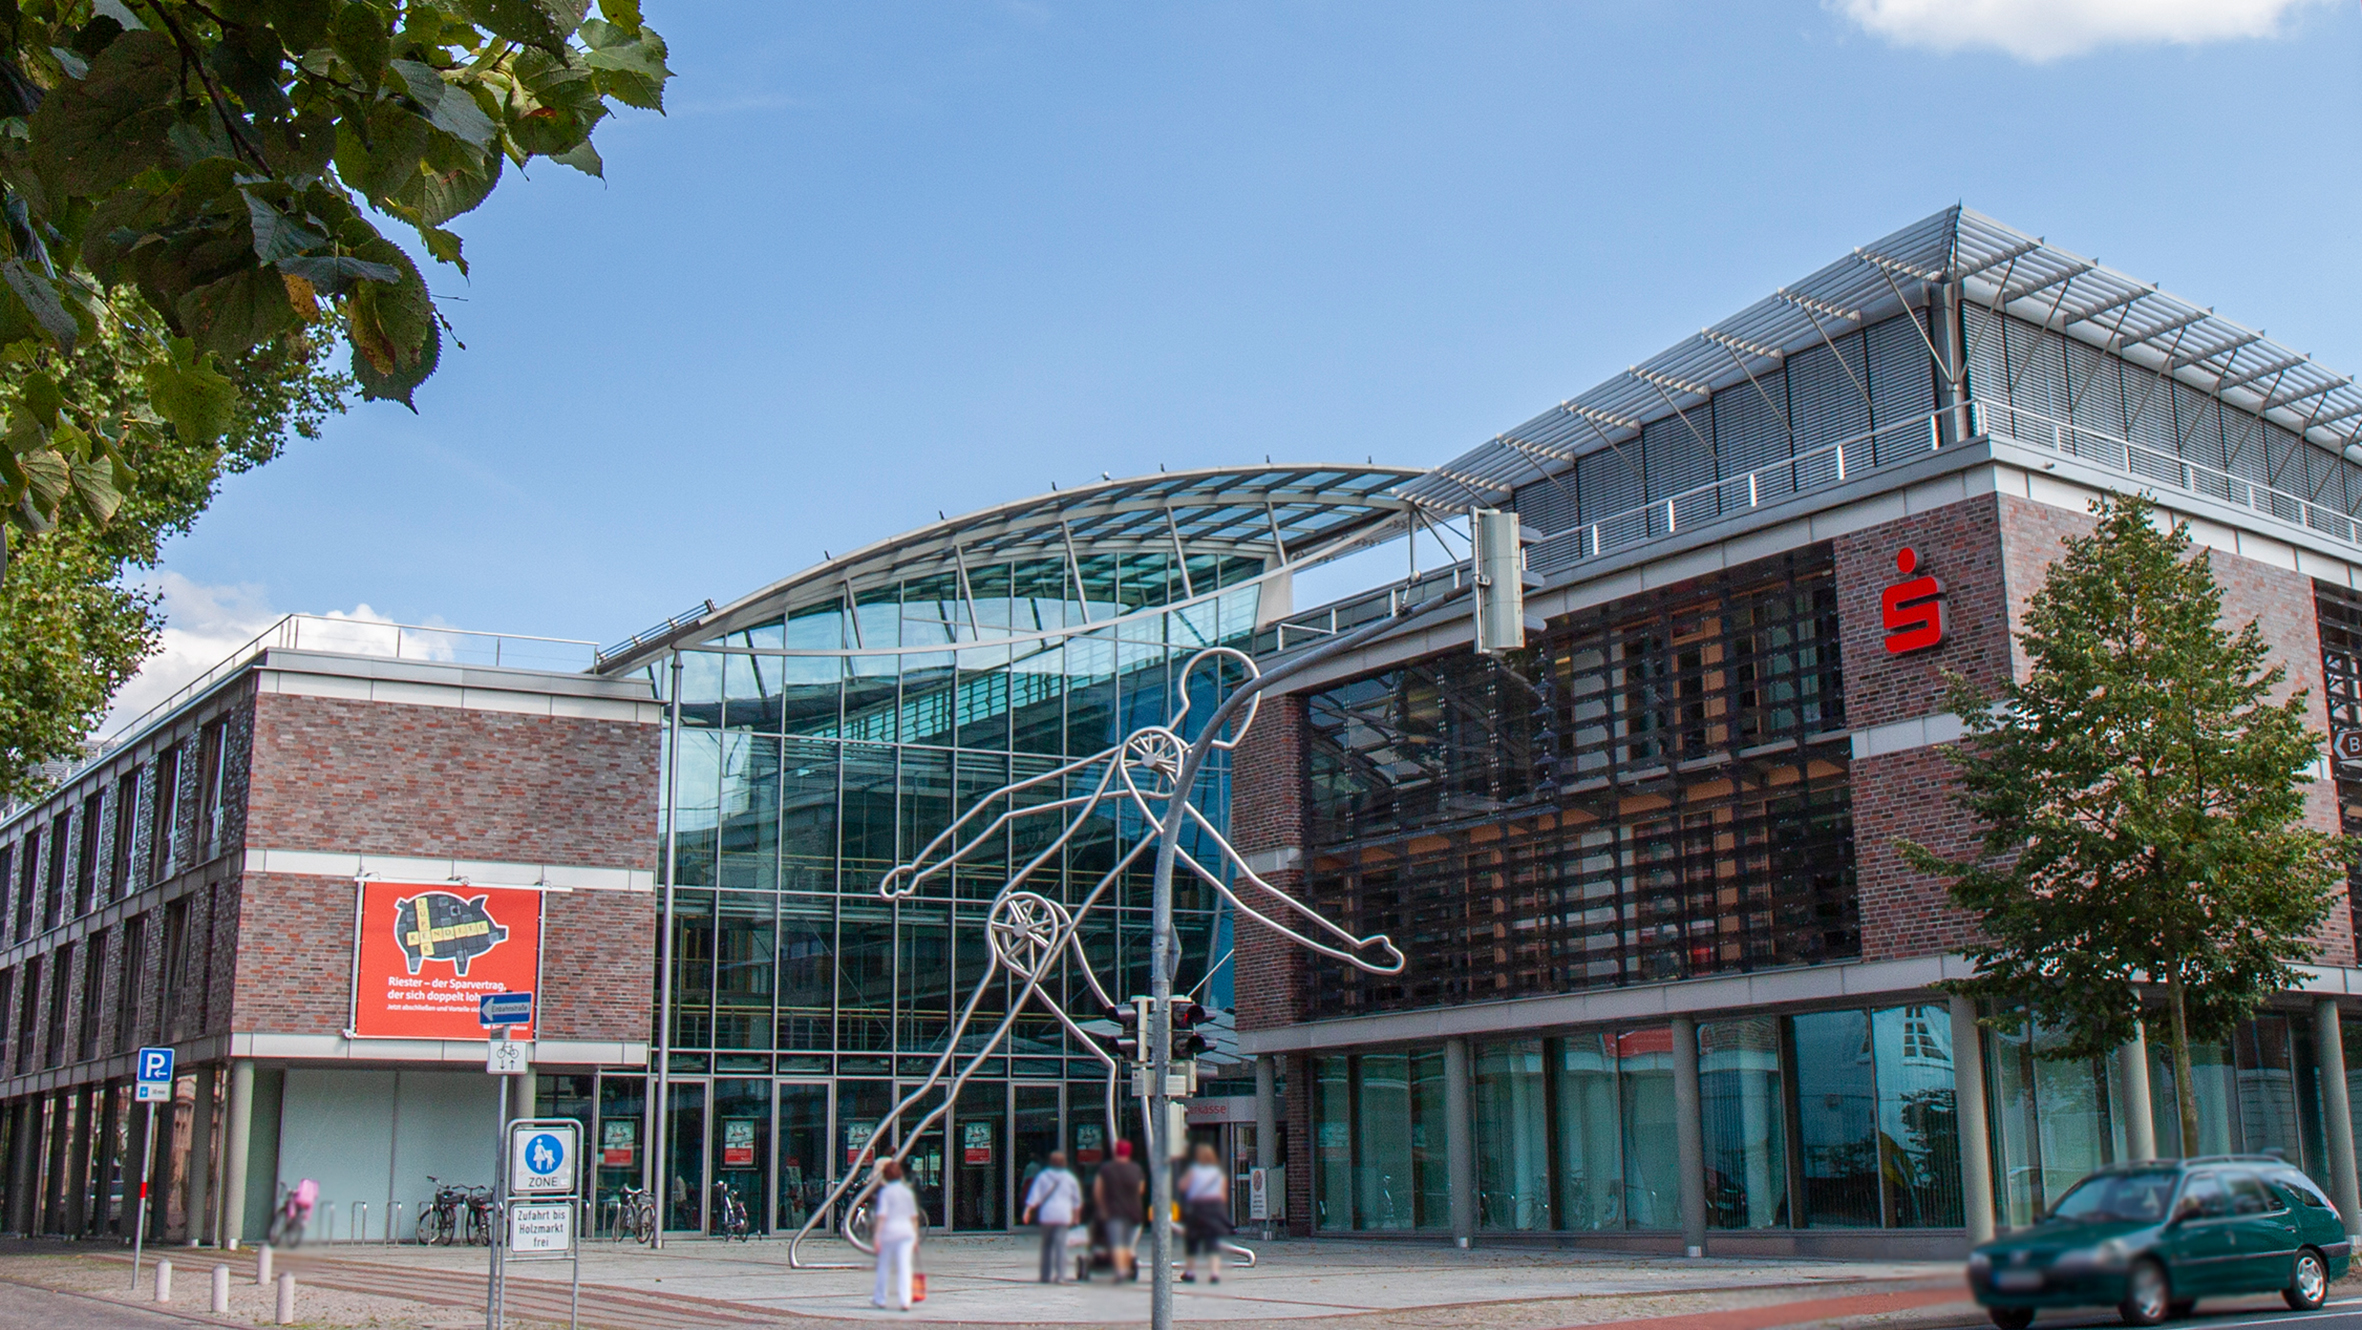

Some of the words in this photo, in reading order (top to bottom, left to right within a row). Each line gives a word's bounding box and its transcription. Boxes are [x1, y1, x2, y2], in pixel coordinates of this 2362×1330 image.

[2348, 736, 2362, 752] B
[408, 922, 487, 943] RENDITE
[417, 899, 432, 954] SUPER
[388, 976, 423, 987] Riester
[432, 977, 448, 988] der
[449, 978, 507, 992] Sparvertrag,
[387, 989, 404, 1000] der
[405, 989, 425, 1000] sich
[427, 990, 464, 1003] doppelt
[465, 991, 481, 1002] loh
[491, 1003, 528, 1013] Einbahnstraße
[145, 1052, 166, 1078] P
[1185, 1103, 1227, 1115] arkasse
[528, 1176, 558, 1187] ZONE
[517, 1209, 550, 1221] Zufahrt
[553, 1208, 566, 1220] bis
[519, 1223, 563, 1234] Holzmarkt
[533, 1237, 549, 1248] frei
